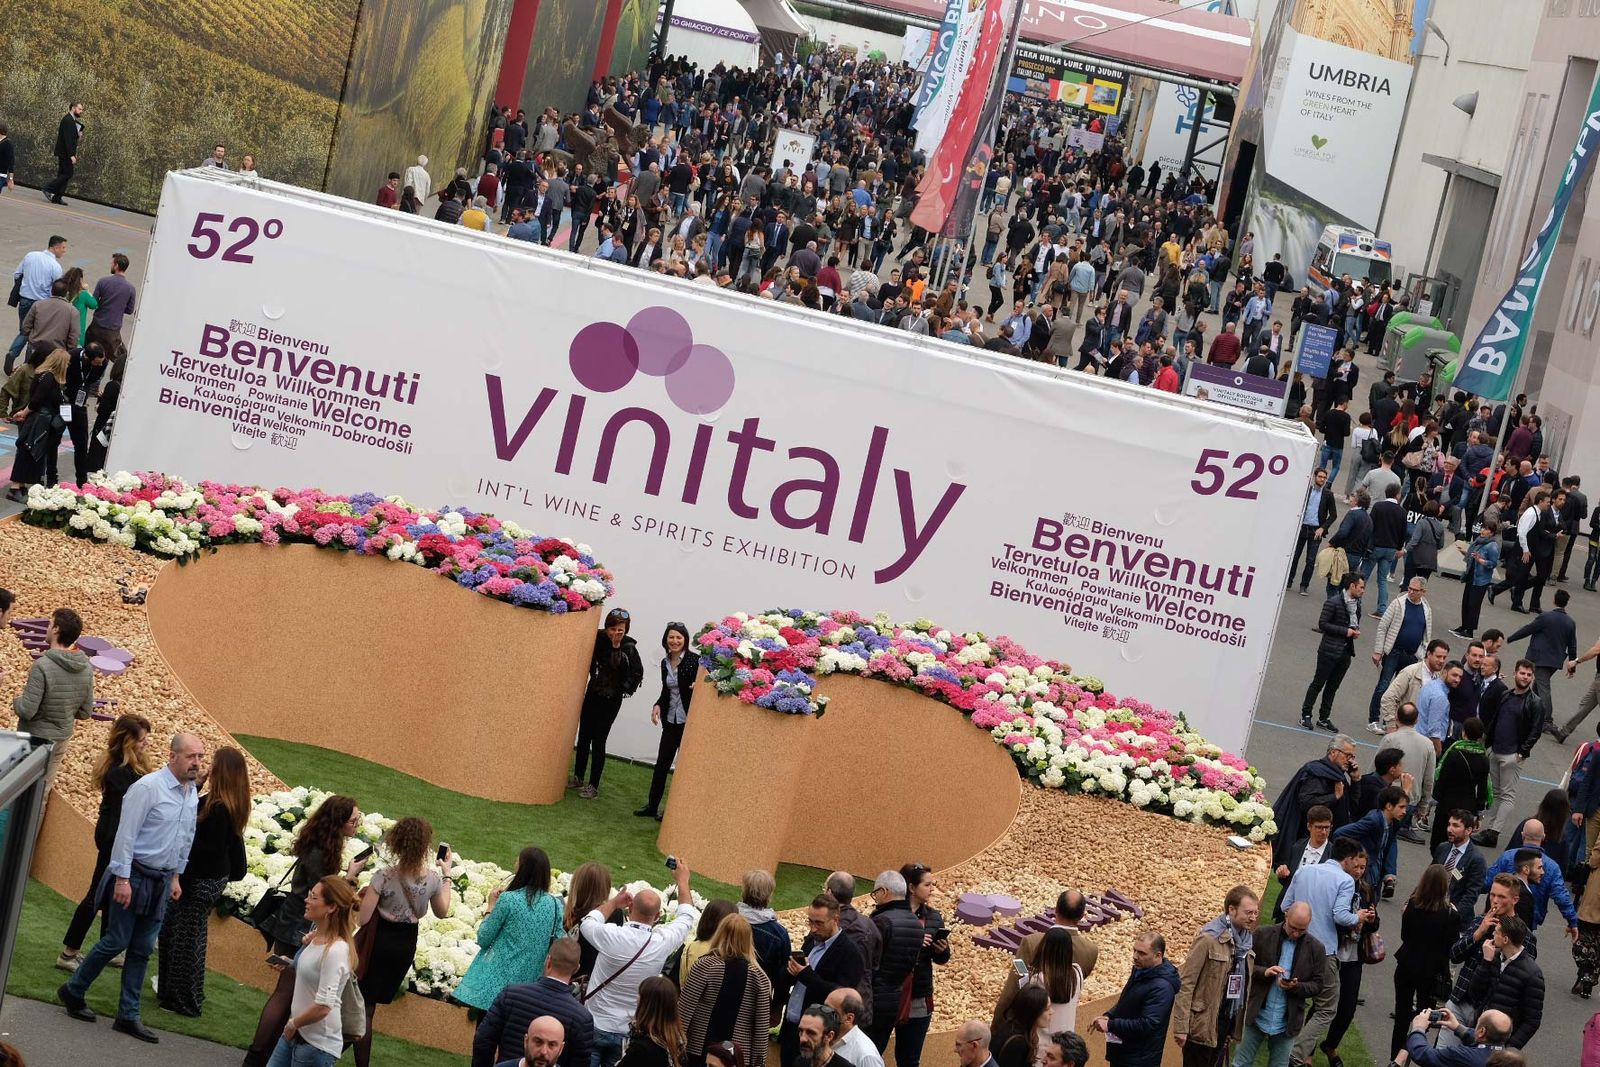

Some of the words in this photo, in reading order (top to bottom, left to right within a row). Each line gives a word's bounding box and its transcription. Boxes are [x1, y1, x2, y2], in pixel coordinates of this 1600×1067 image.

[658, 15, 680, 25] PTO
[680, 20, 712, 32] GHIACCIO
[718, 28, 729, 36] ICE
[729, 32, 749, 40] POINT
[1305, 88, 1330, 101] WINES
[1332, 94, 1355, 106] FROM
[1357, 100, 1373, 110] THE
[1309, 62, 1391, 96] UMBRIA
[1300, 108, 1312, 116] OF
[1312, 111, 1334, 121] ITALY
[1302, 99, 1329, 111] GREEN
[1330, 104, 1357, 116] HEART
[1159, 156, 1185, 165] piccol
[258, 328, 329, 355] Bienvenu
[171, 350, 266, 387] Tervetuloa
[275, 373, 380, 412] Willkommen
[199, 324, 420, 405] Benvenuti
[159, 364, 235, 392] Velkommen
[248, 387, 308, 411] Powitanie
[312, 400, 412, 438] Welcome
[159, 388, 260, 426] Bienvenida
[262, 417, 306, 436] Welkom
[1213, 387, 1236, 396] VINITALY
[1236, 393, 1263, 402] BOUTIQUE
[277, 410, 331, 433] Velkomin
[332, 425, 413, 455] Dobrodošli
[485, 373, 967, 584] vinitaly
[477, 478, 533, 507] INT'L
[544, 493, 601, 521] WINE
[610, 512, 622, 527] &
[631, 515, 714, 548] SPIRITS
[724, 536, 856, 581] EXHIBITION
[1091, 520, 1164, 548] Bienvenu
[1003, 544, 1100, 580] Tervetuloa
[1109, 567, 1214, 605] Willkommen
[1032, 517, 1256, 598] Benvenuti
[990, 581, 1093, 619] Bienvenida
[1095, 611, 1138, 630] Welkom
[991, 557, 1068, 585] Velkommen
[1081, 581, 1141, 604] Powitanie
[1144, 592, 1246, 632] Welcome
[1109, 603, 1164, 626] Velkomin
[1164, 618, 1246, 648] Dobrodošli
